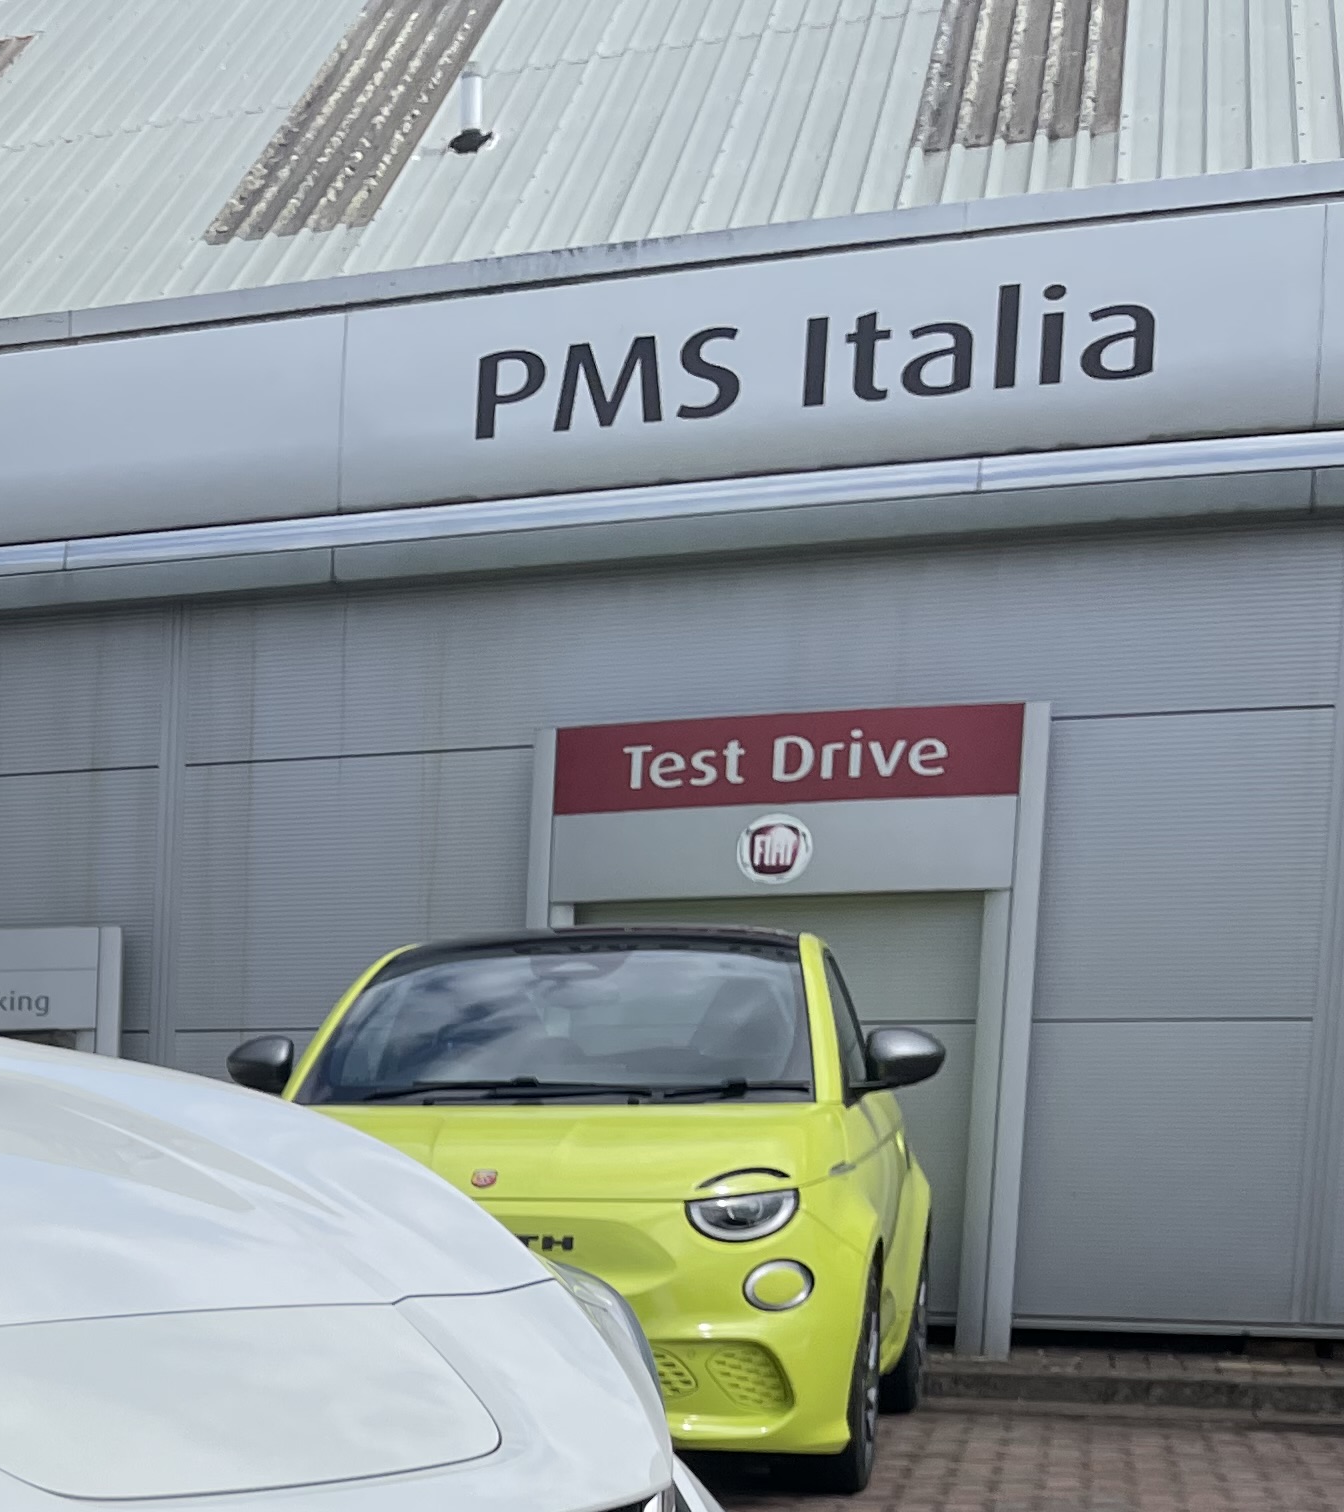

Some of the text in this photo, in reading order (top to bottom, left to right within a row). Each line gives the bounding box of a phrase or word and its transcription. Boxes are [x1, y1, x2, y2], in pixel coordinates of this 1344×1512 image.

[475, 283, 1157, 440] PMS Italia
[622, 729, 950, 791] Test Drive
